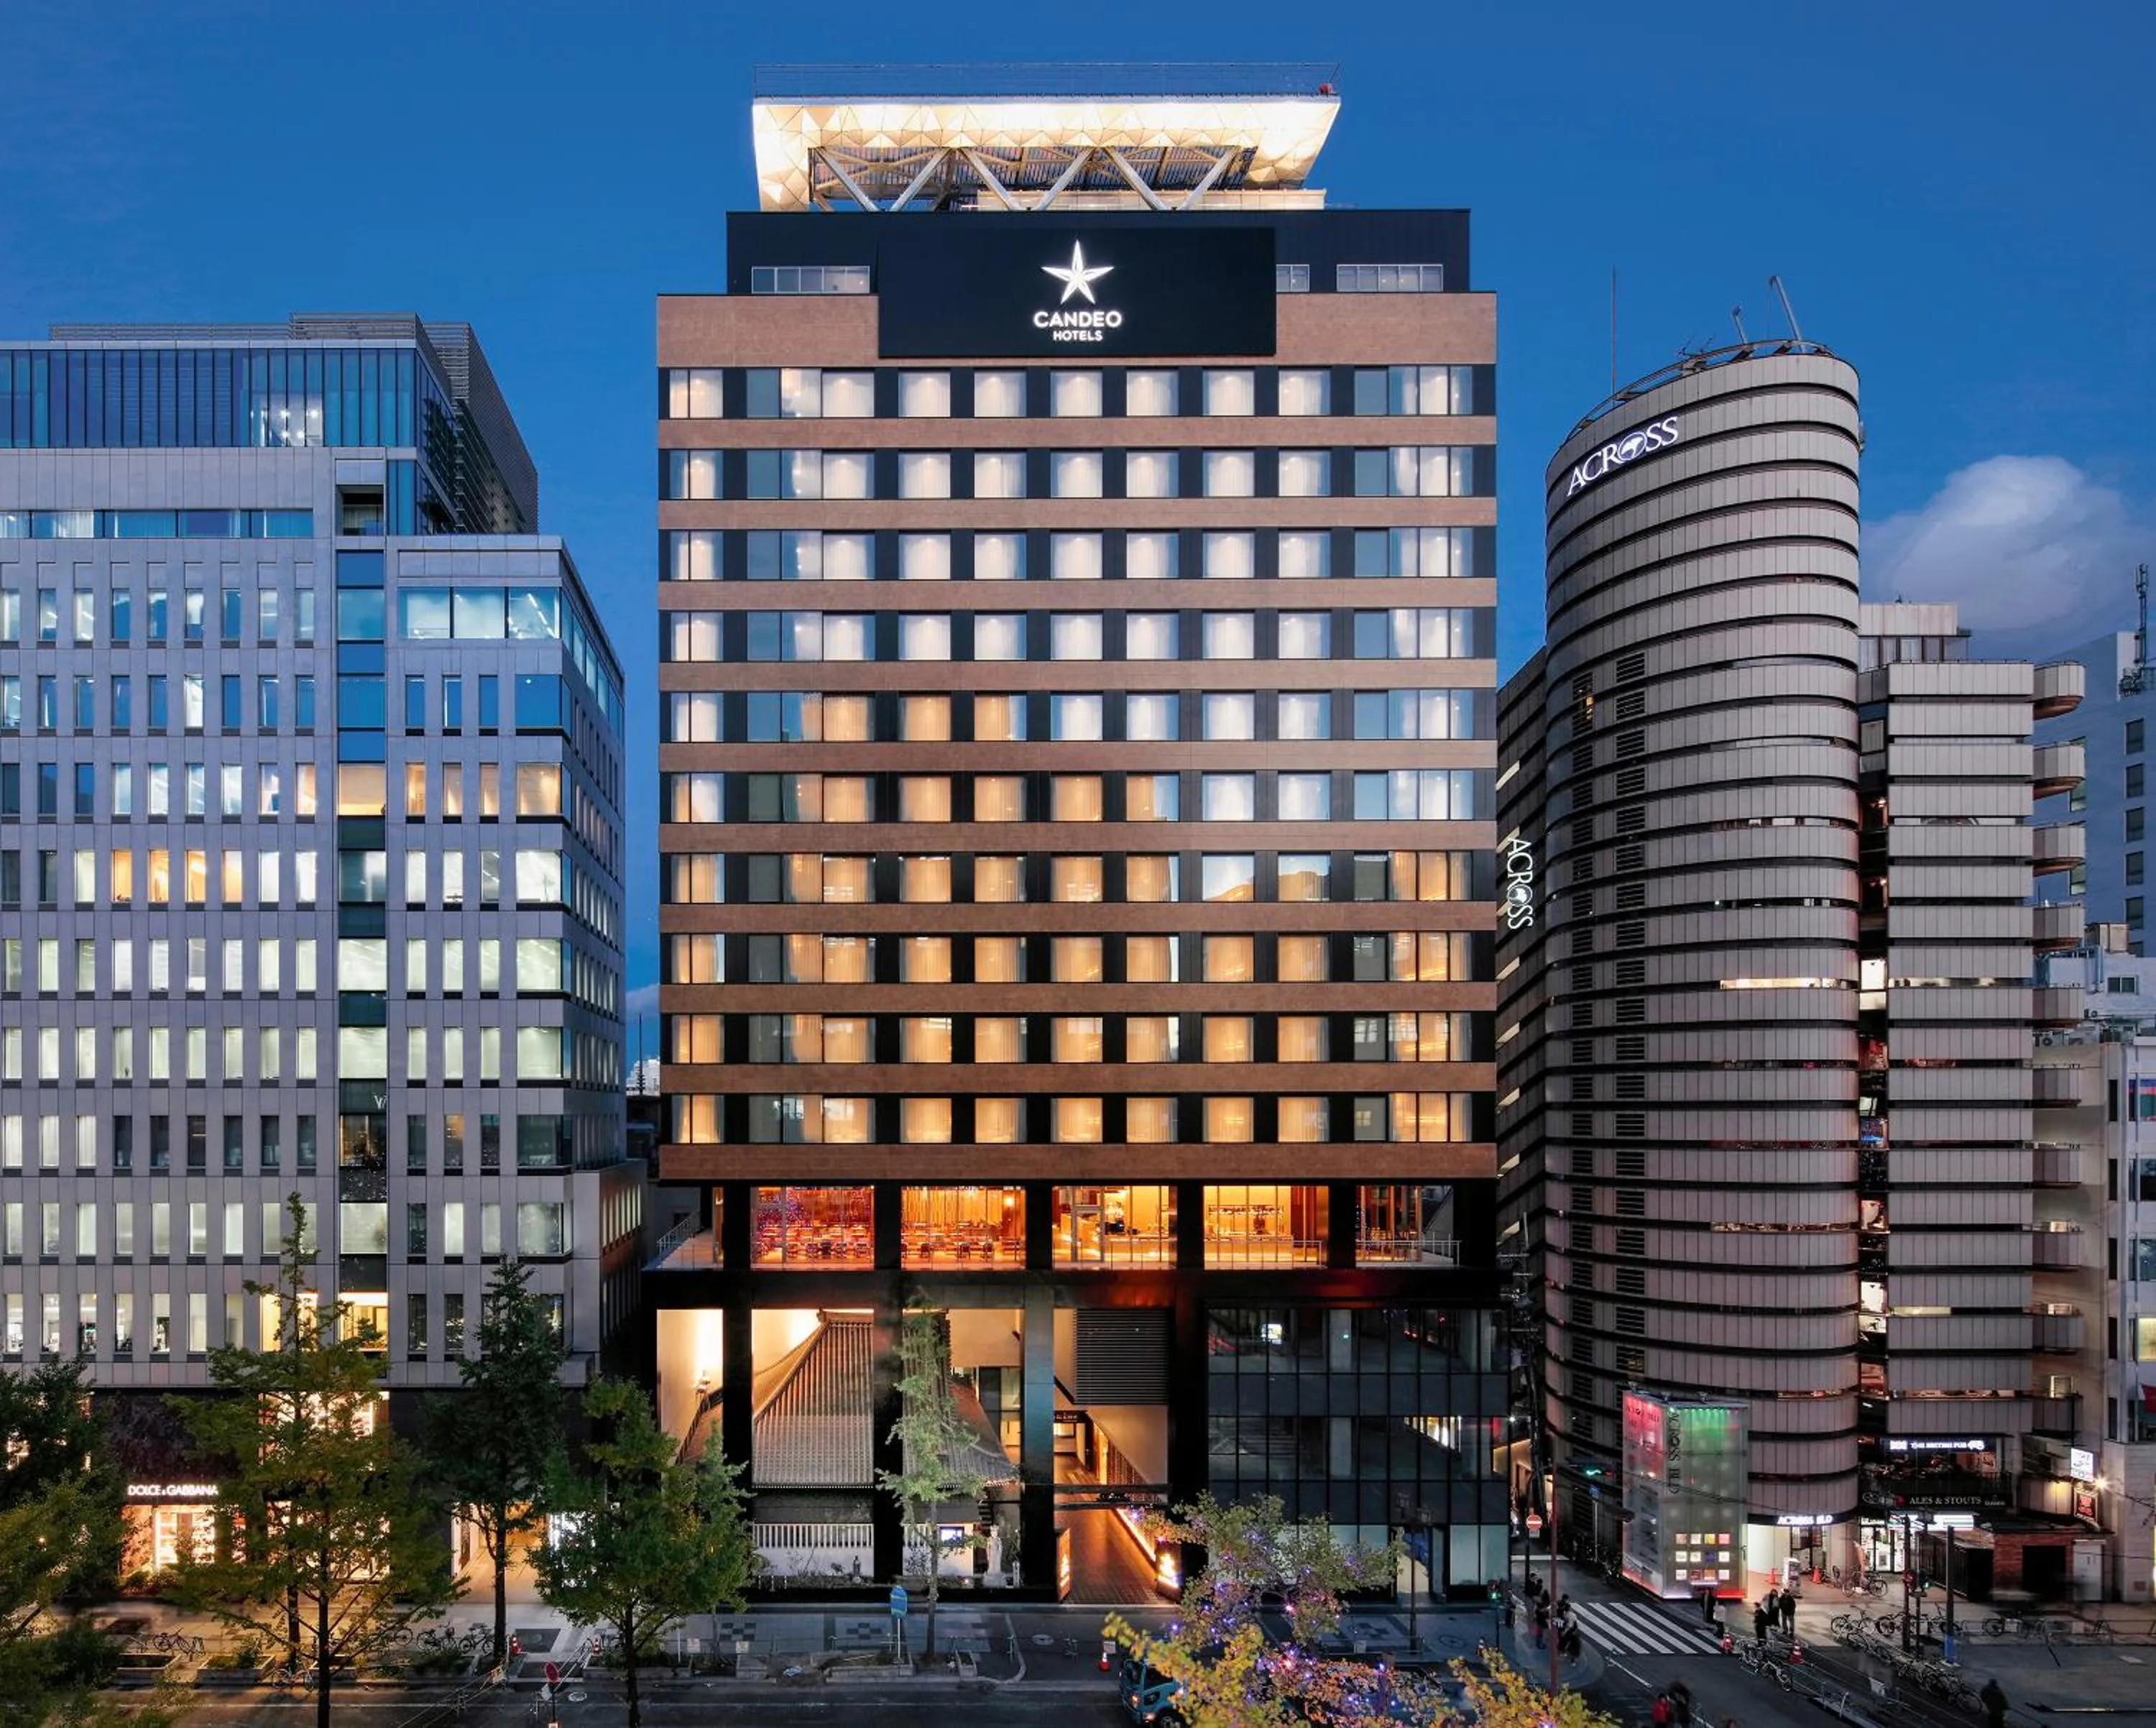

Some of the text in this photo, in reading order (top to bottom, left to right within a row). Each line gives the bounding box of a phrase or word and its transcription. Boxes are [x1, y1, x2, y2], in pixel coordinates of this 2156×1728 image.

[1033, 311, 1123, 328] CANDEO
[1053, 330, 1103, 341] HOTELS
[1567, 416, 1679, 497] ACROSS
[1506, 839, 1534, 929] ACROSS
[128, 1484, 162, 1496] DOLCE
[166, 1484, 218, 1496] GABBANA
[1944, 1496, 1982, 1504] STOUTS
